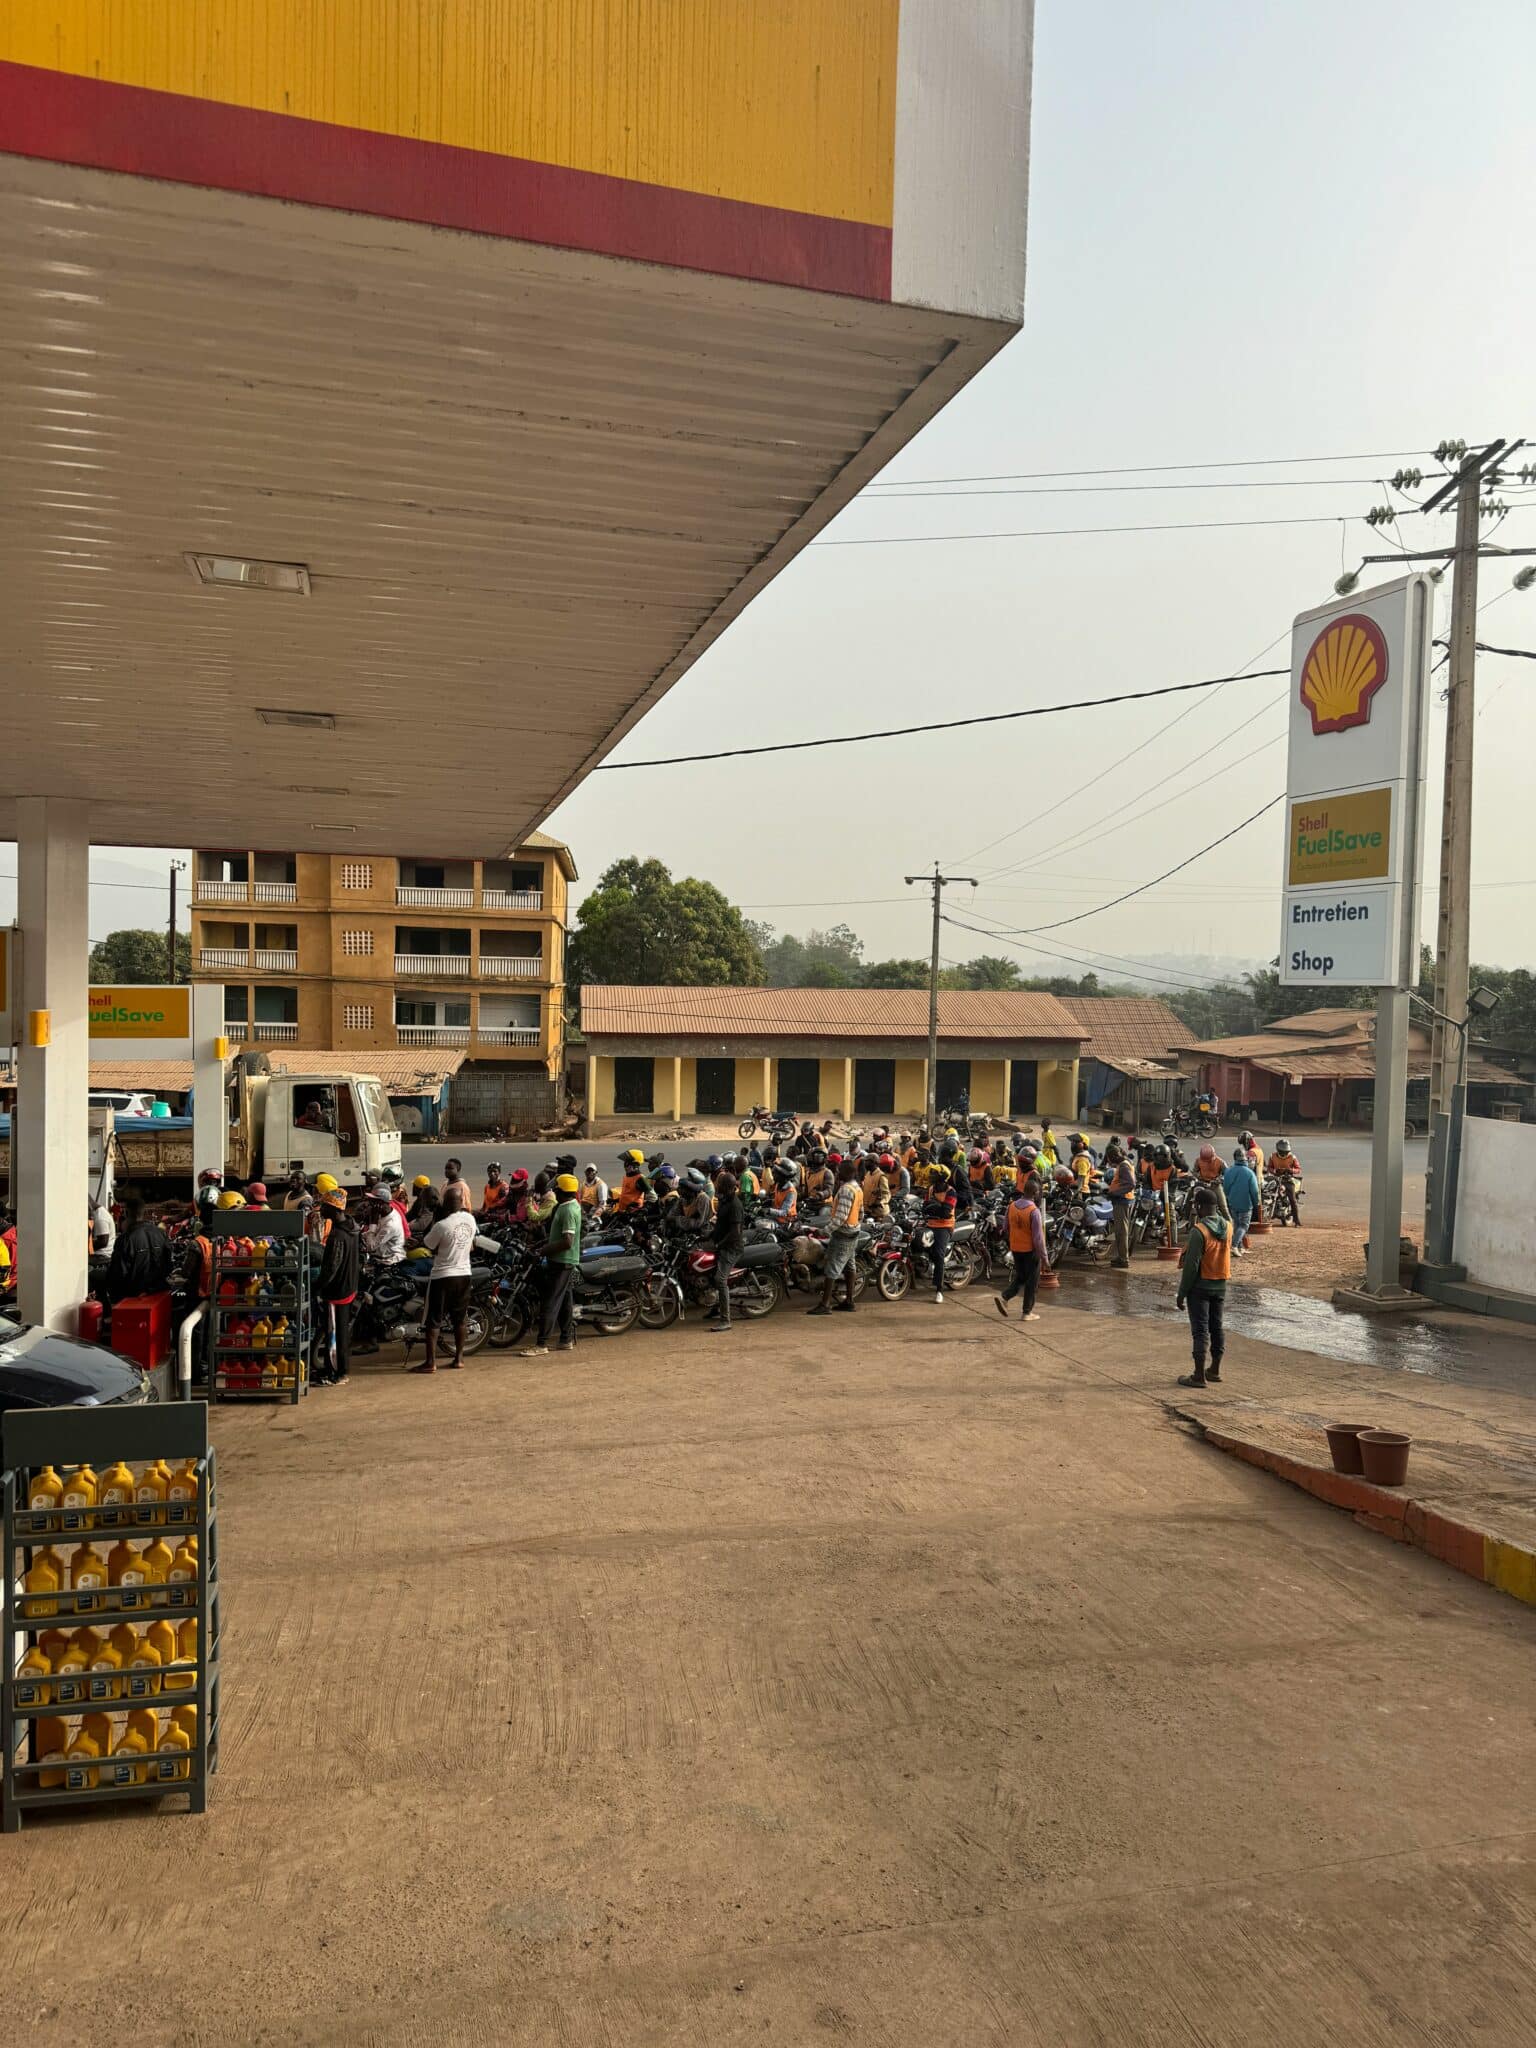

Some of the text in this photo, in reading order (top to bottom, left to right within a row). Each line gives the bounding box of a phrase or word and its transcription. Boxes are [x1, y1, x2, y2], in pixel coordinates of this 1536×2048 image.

[1299, 813, 1328, 832] Shell
[1297, 829, 1382, 856] FuelSave
[1292, 900, 1369, 923] Entretien
[1291, 950, 1334, 976] Shop
[88, 995, 112, 1006] hell
[88, 1007, 164, 1022] uelSave
